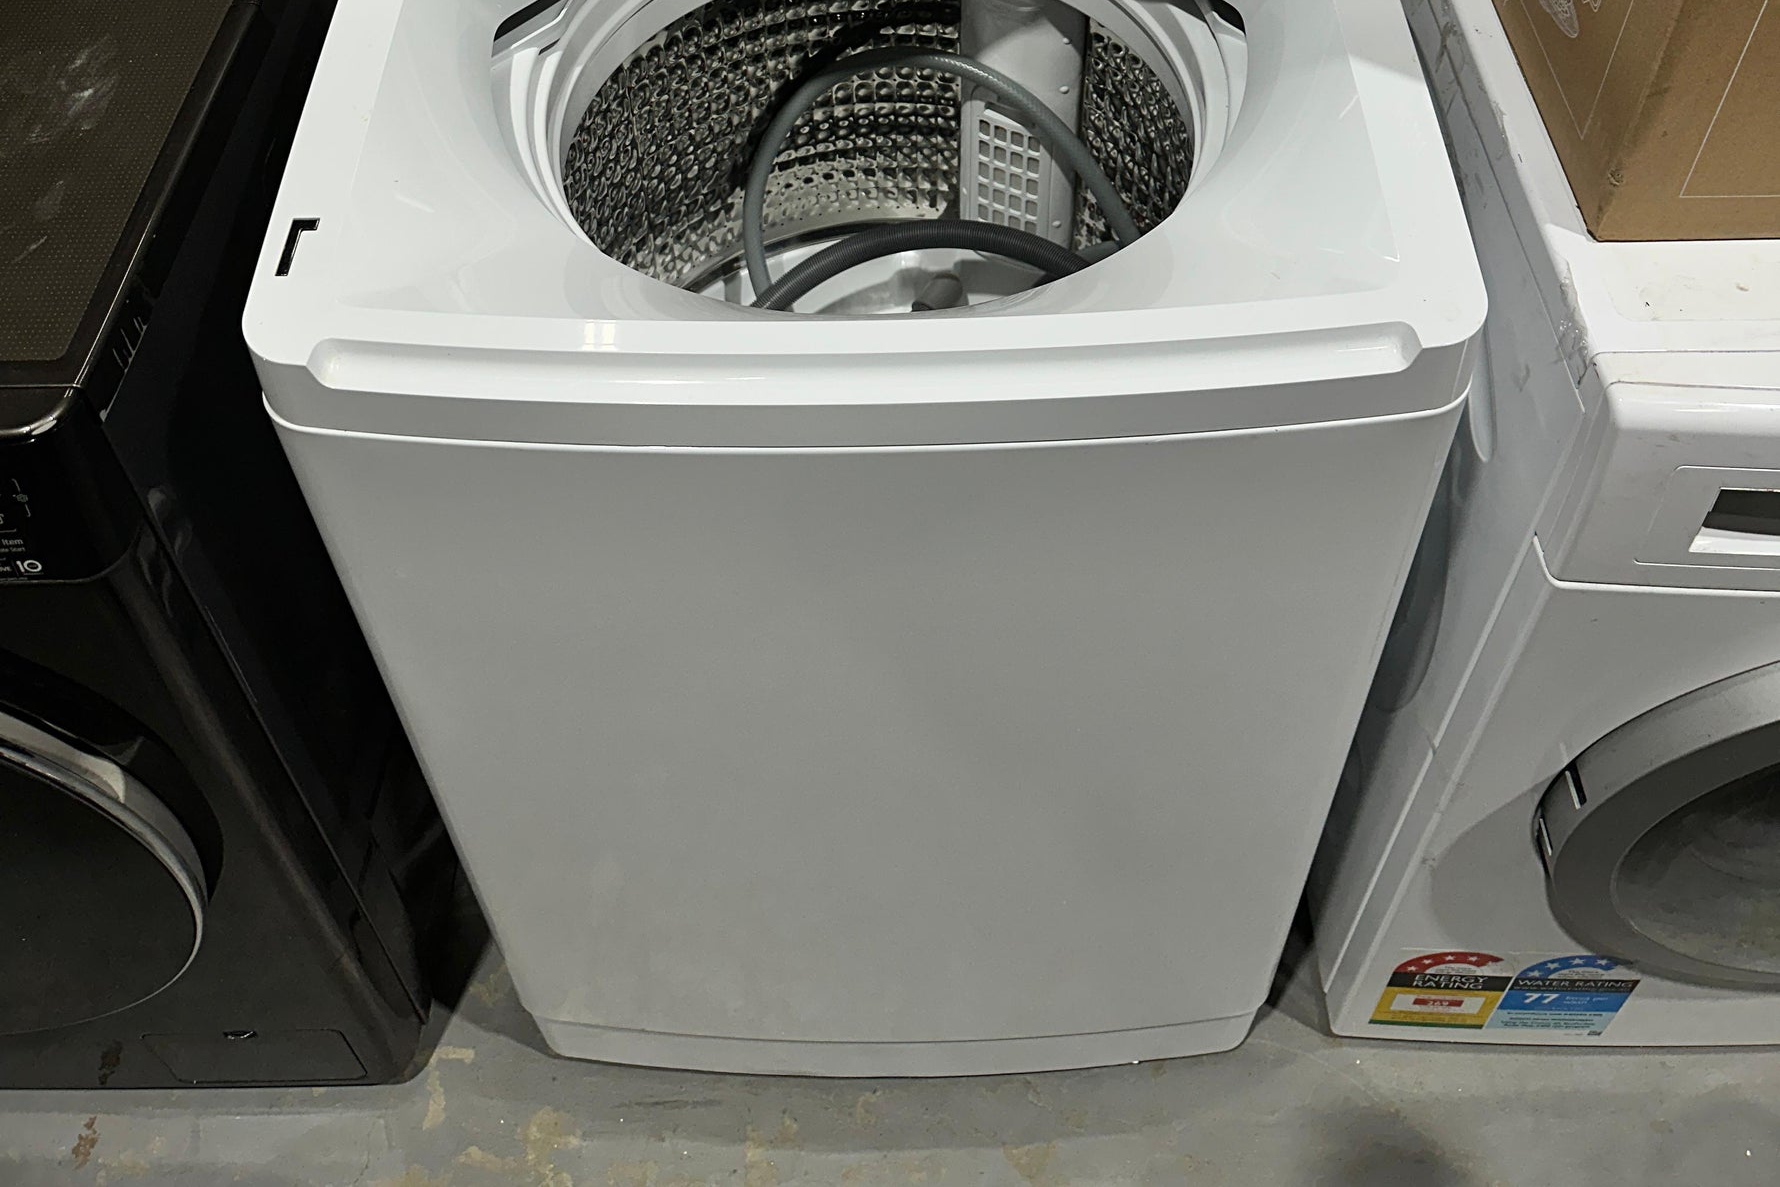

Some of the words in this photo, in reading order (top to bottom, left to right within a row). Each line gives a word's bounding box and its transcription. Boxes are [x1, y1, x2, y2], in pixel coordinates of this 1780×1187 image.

[1415, 974, 1488, 983] ENERGY
[1412, 980, 1484, 989] RATING
[1518, 979, 1570, 987] WATER
[1575, 980, 1634, 988] RATING
[1523, 993, 1560, 1004] 77
